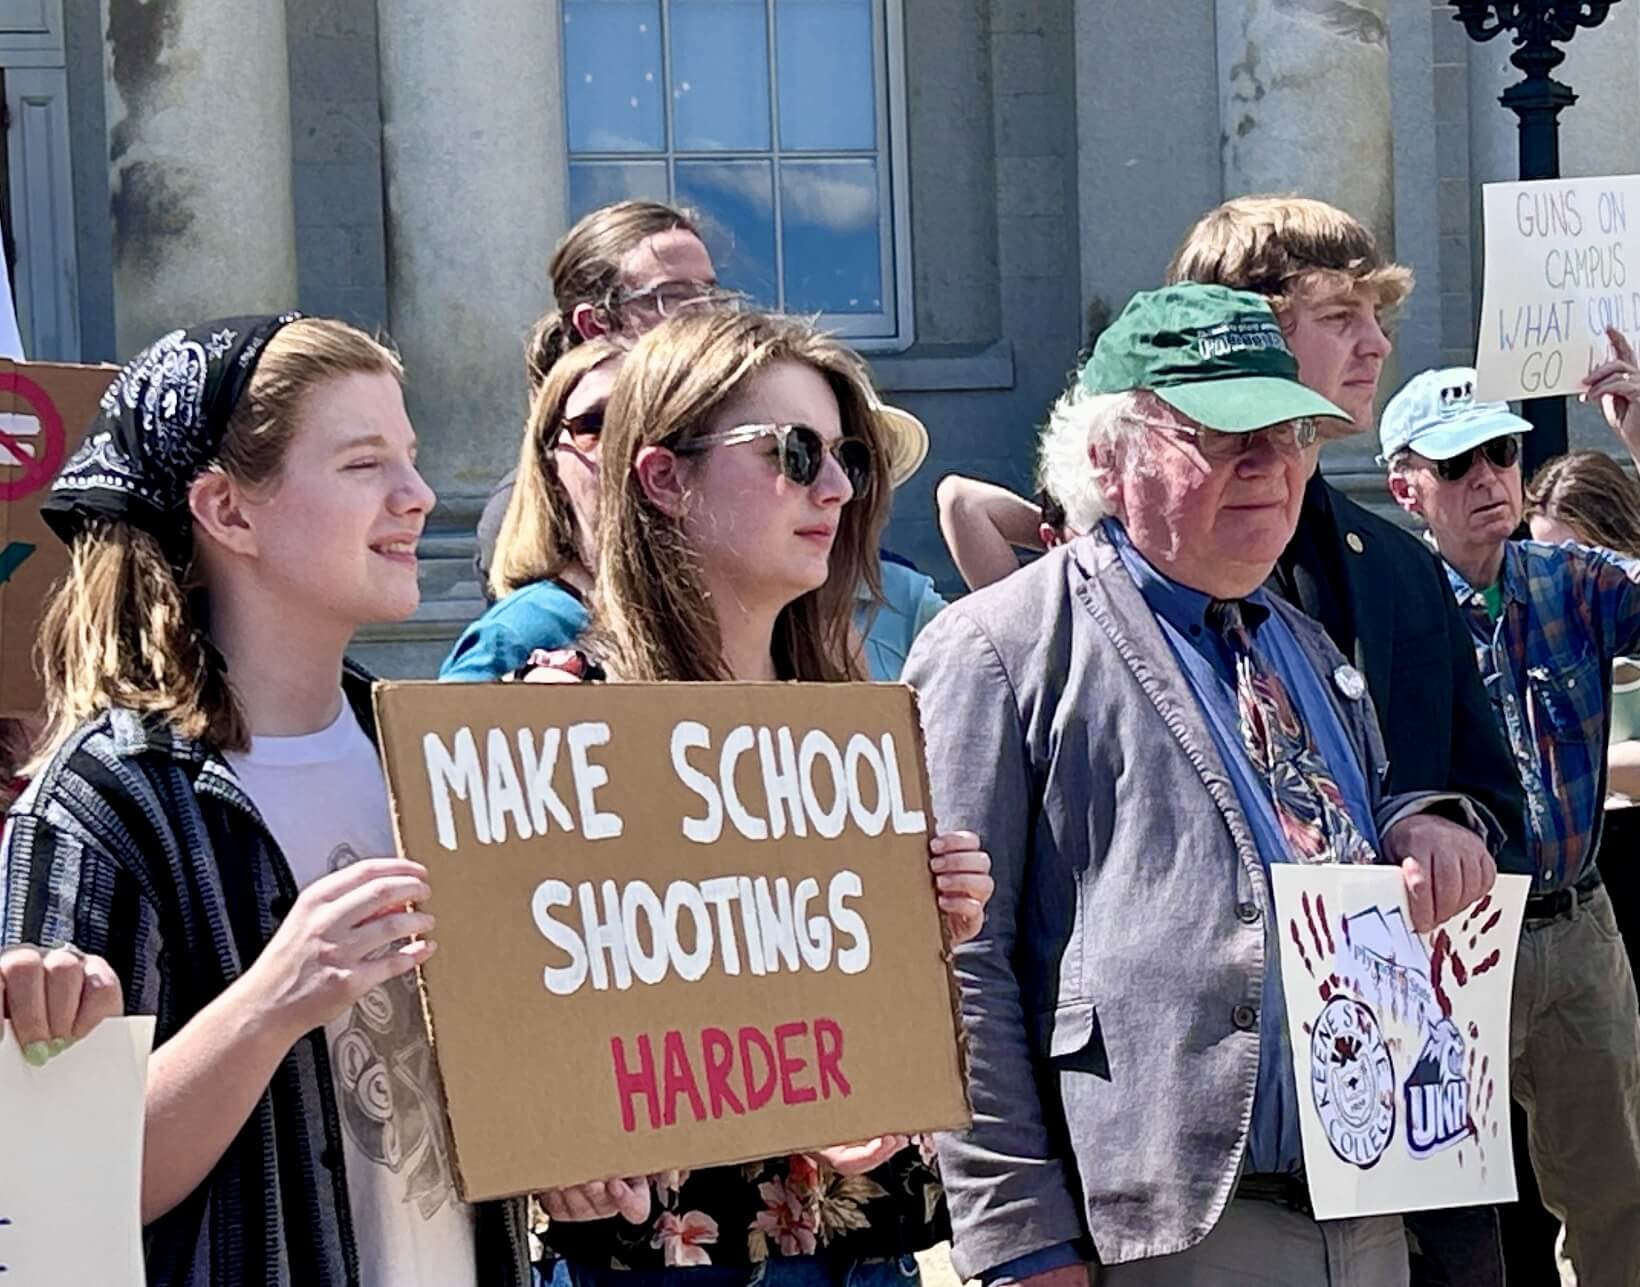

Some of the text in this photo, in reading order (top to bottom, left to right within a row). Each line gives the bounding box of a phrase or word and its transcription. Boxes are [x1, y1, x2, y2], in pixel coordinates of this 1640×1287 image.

[1515, 189, 1627, 237] GUNS ON
[1545, 242, 1627, 290] CAMPUS
[1499, 299, 1575, 351] WHAT
[1520, 349, 1563, 392] GO
[422, 721, 928, 851] MAKE SCHOOL
[531, 870, 872, 996] SHOOTINGS
[611, 1018, 852, 1132] HARDER
[1312, 1008, 1339, 1108] KEENE
[1407, 1080, 1469, 1149] UNH
